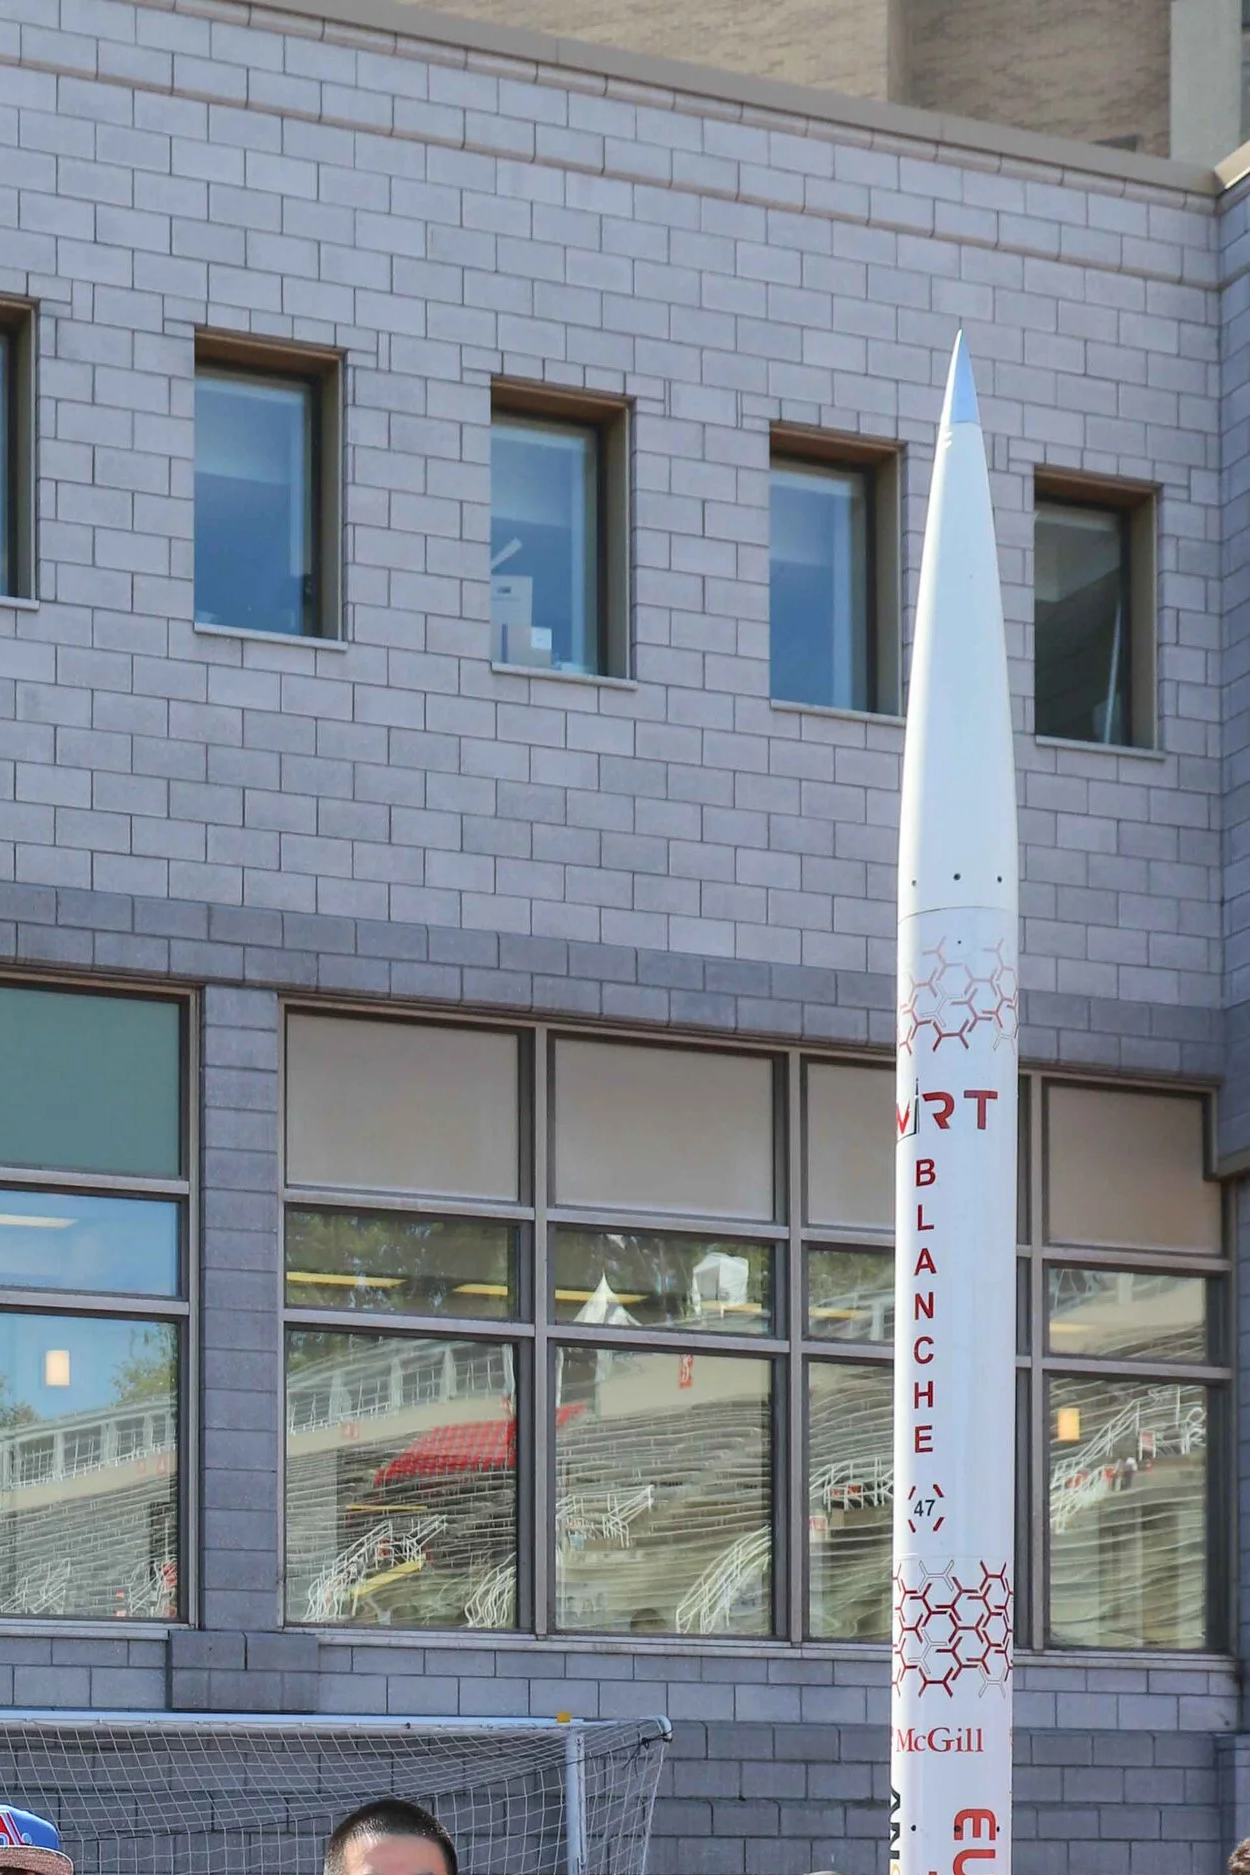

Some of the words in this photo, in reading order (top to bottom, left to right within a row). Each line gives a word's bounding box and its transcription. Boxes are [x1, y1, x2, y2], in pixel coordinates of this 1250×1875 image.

[914, 1158, 938, 1454] BLANCHE
[913, 1498, 936, 1518] 47
[896, 1727, 984, 1753] McGill
